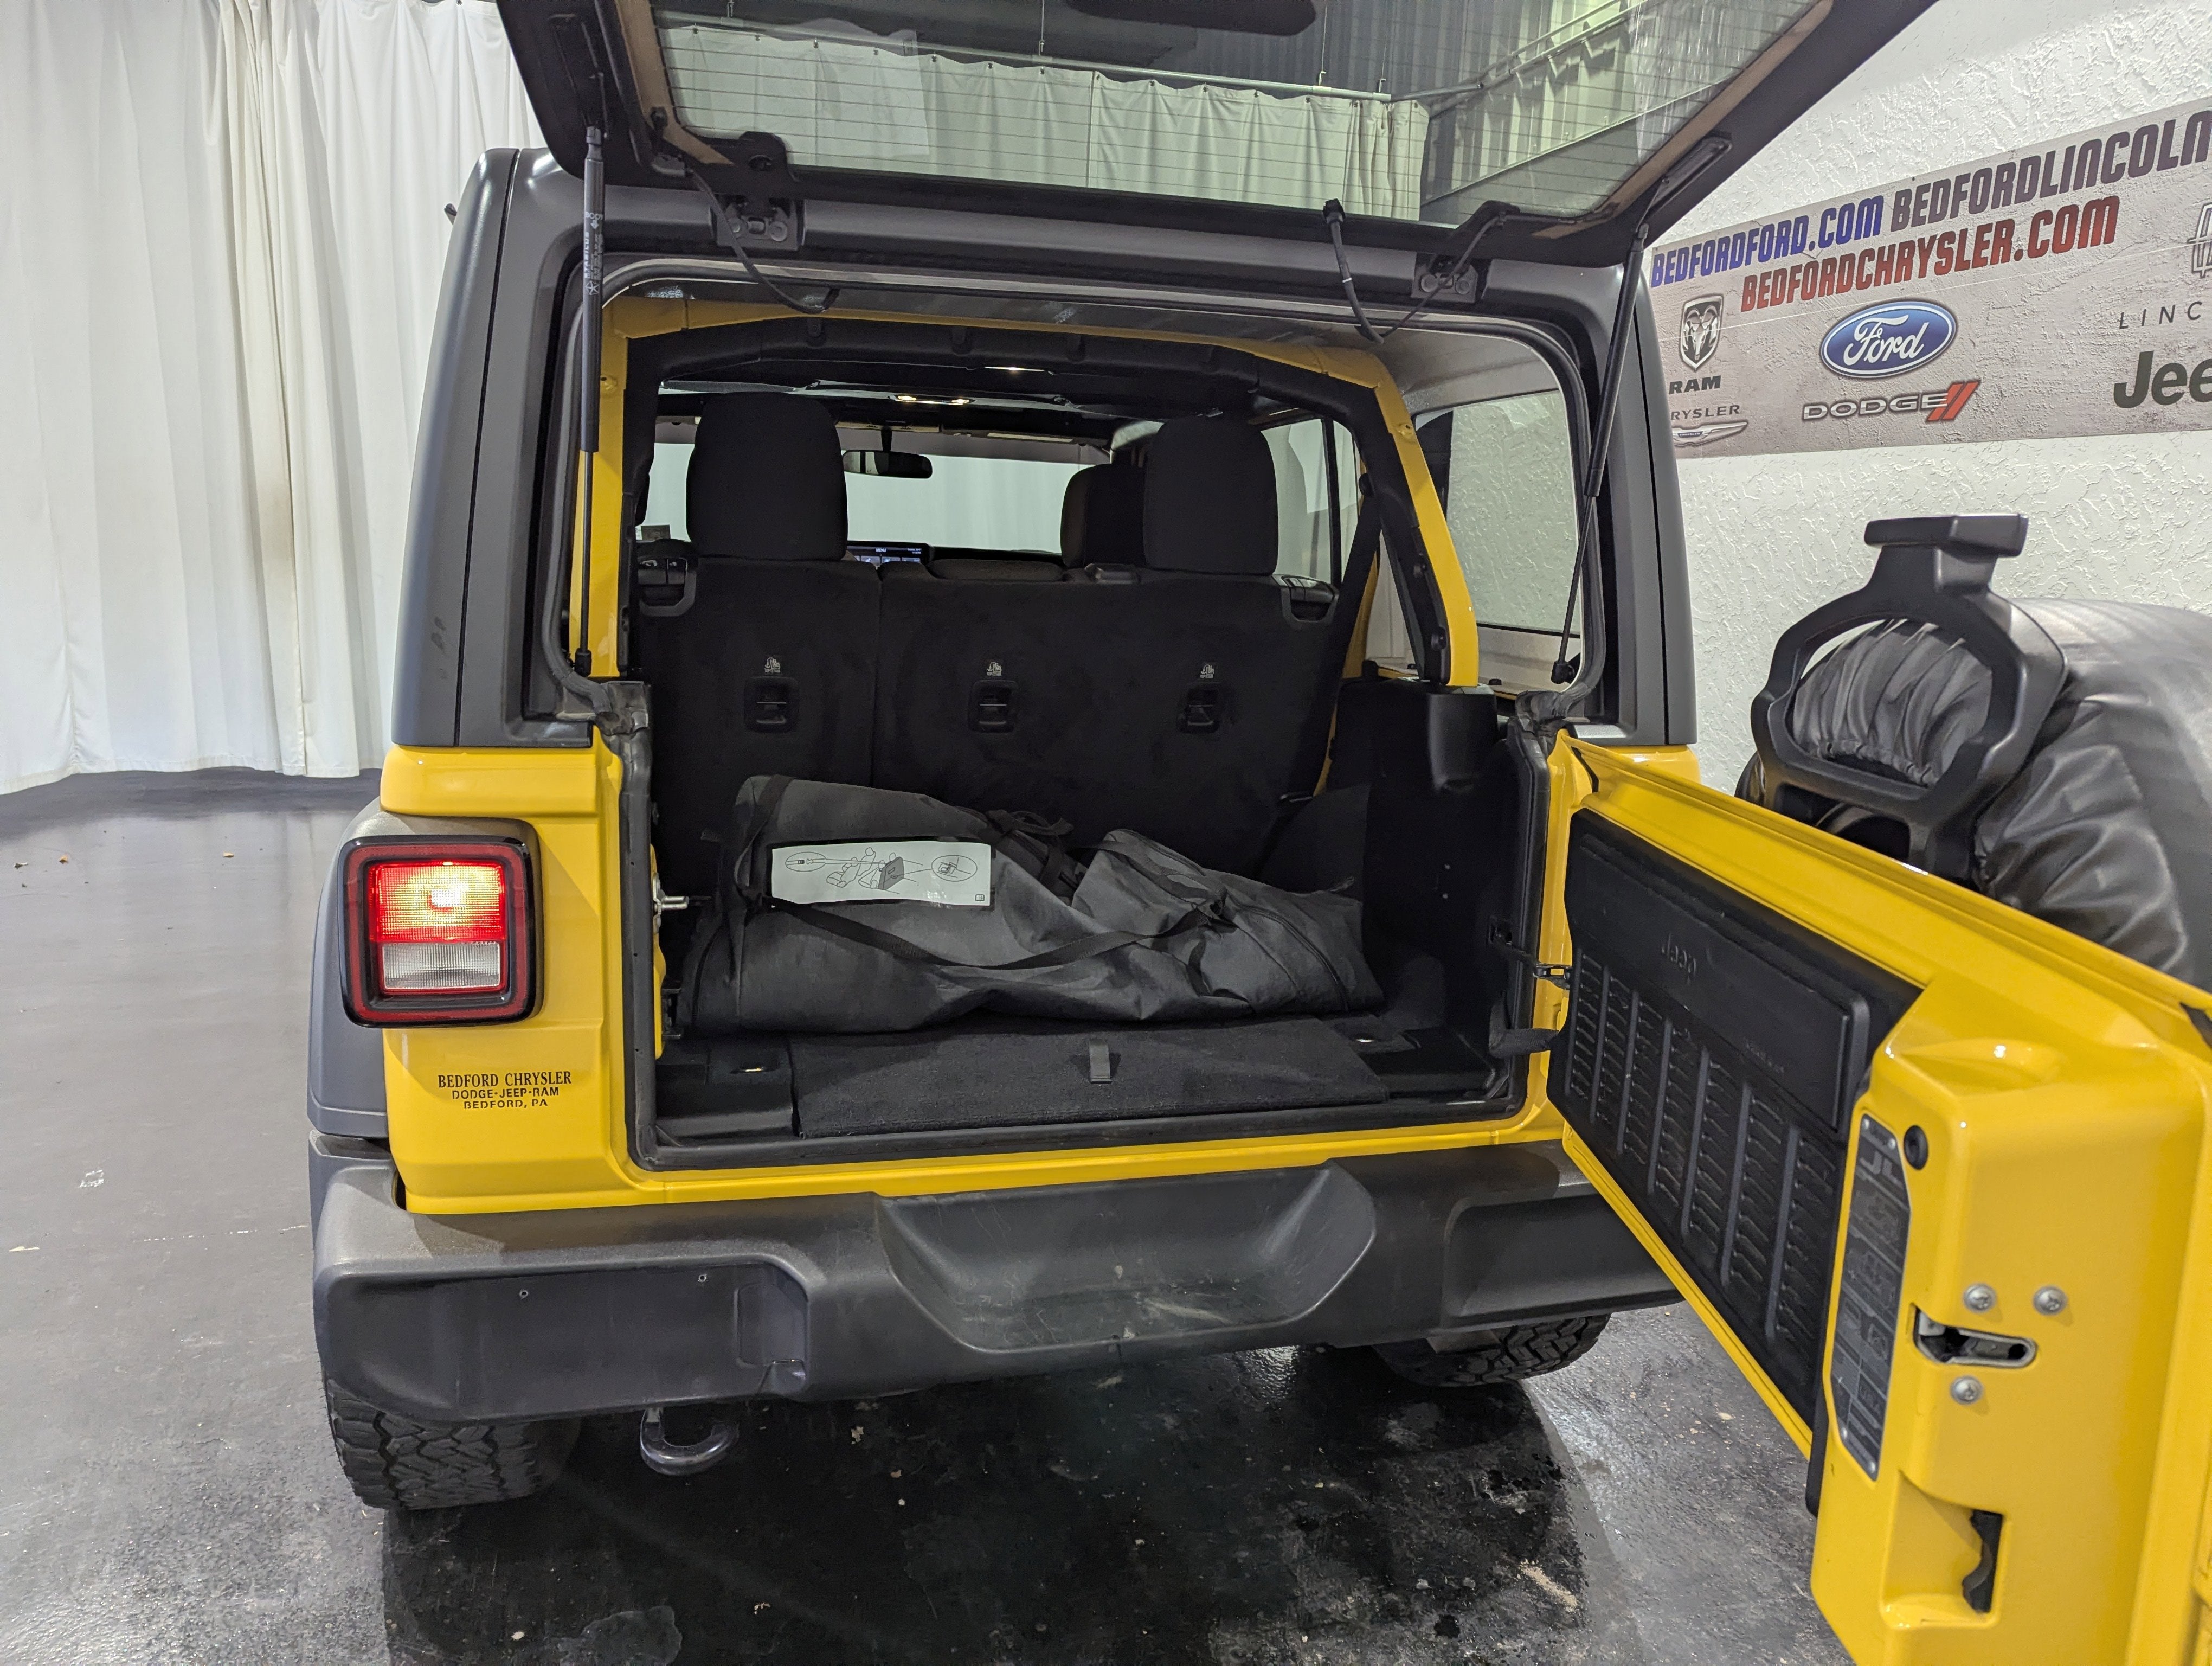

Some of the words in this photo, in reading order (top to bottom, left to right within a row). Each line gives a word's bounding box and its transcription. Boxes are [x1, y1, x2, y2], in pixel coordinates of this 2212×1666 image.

[1651, 195, 1885, 288] BEDFORDFORD.COM
[1741, 195, 2120, 312] BEDFORDCHRYSLER.COM
[2119, 301, 2203, 330] LINC
[1843, 315, 1930, 366] Ford
[1669, 375, 1721, 395] RAM
[2114, 350, 2212, 408] Jee
[1670, 405, 1740, 421] RYSLER
[1803, 392, 1949, 420] DODGE
[438, 1074, 499, 1088] BEDFORD
[505, 1071, 572, 1086] CHRYSLER
[464, 1099, 527, 1110] BEDFORD,
[531, 1098, 548, 1107] PA
